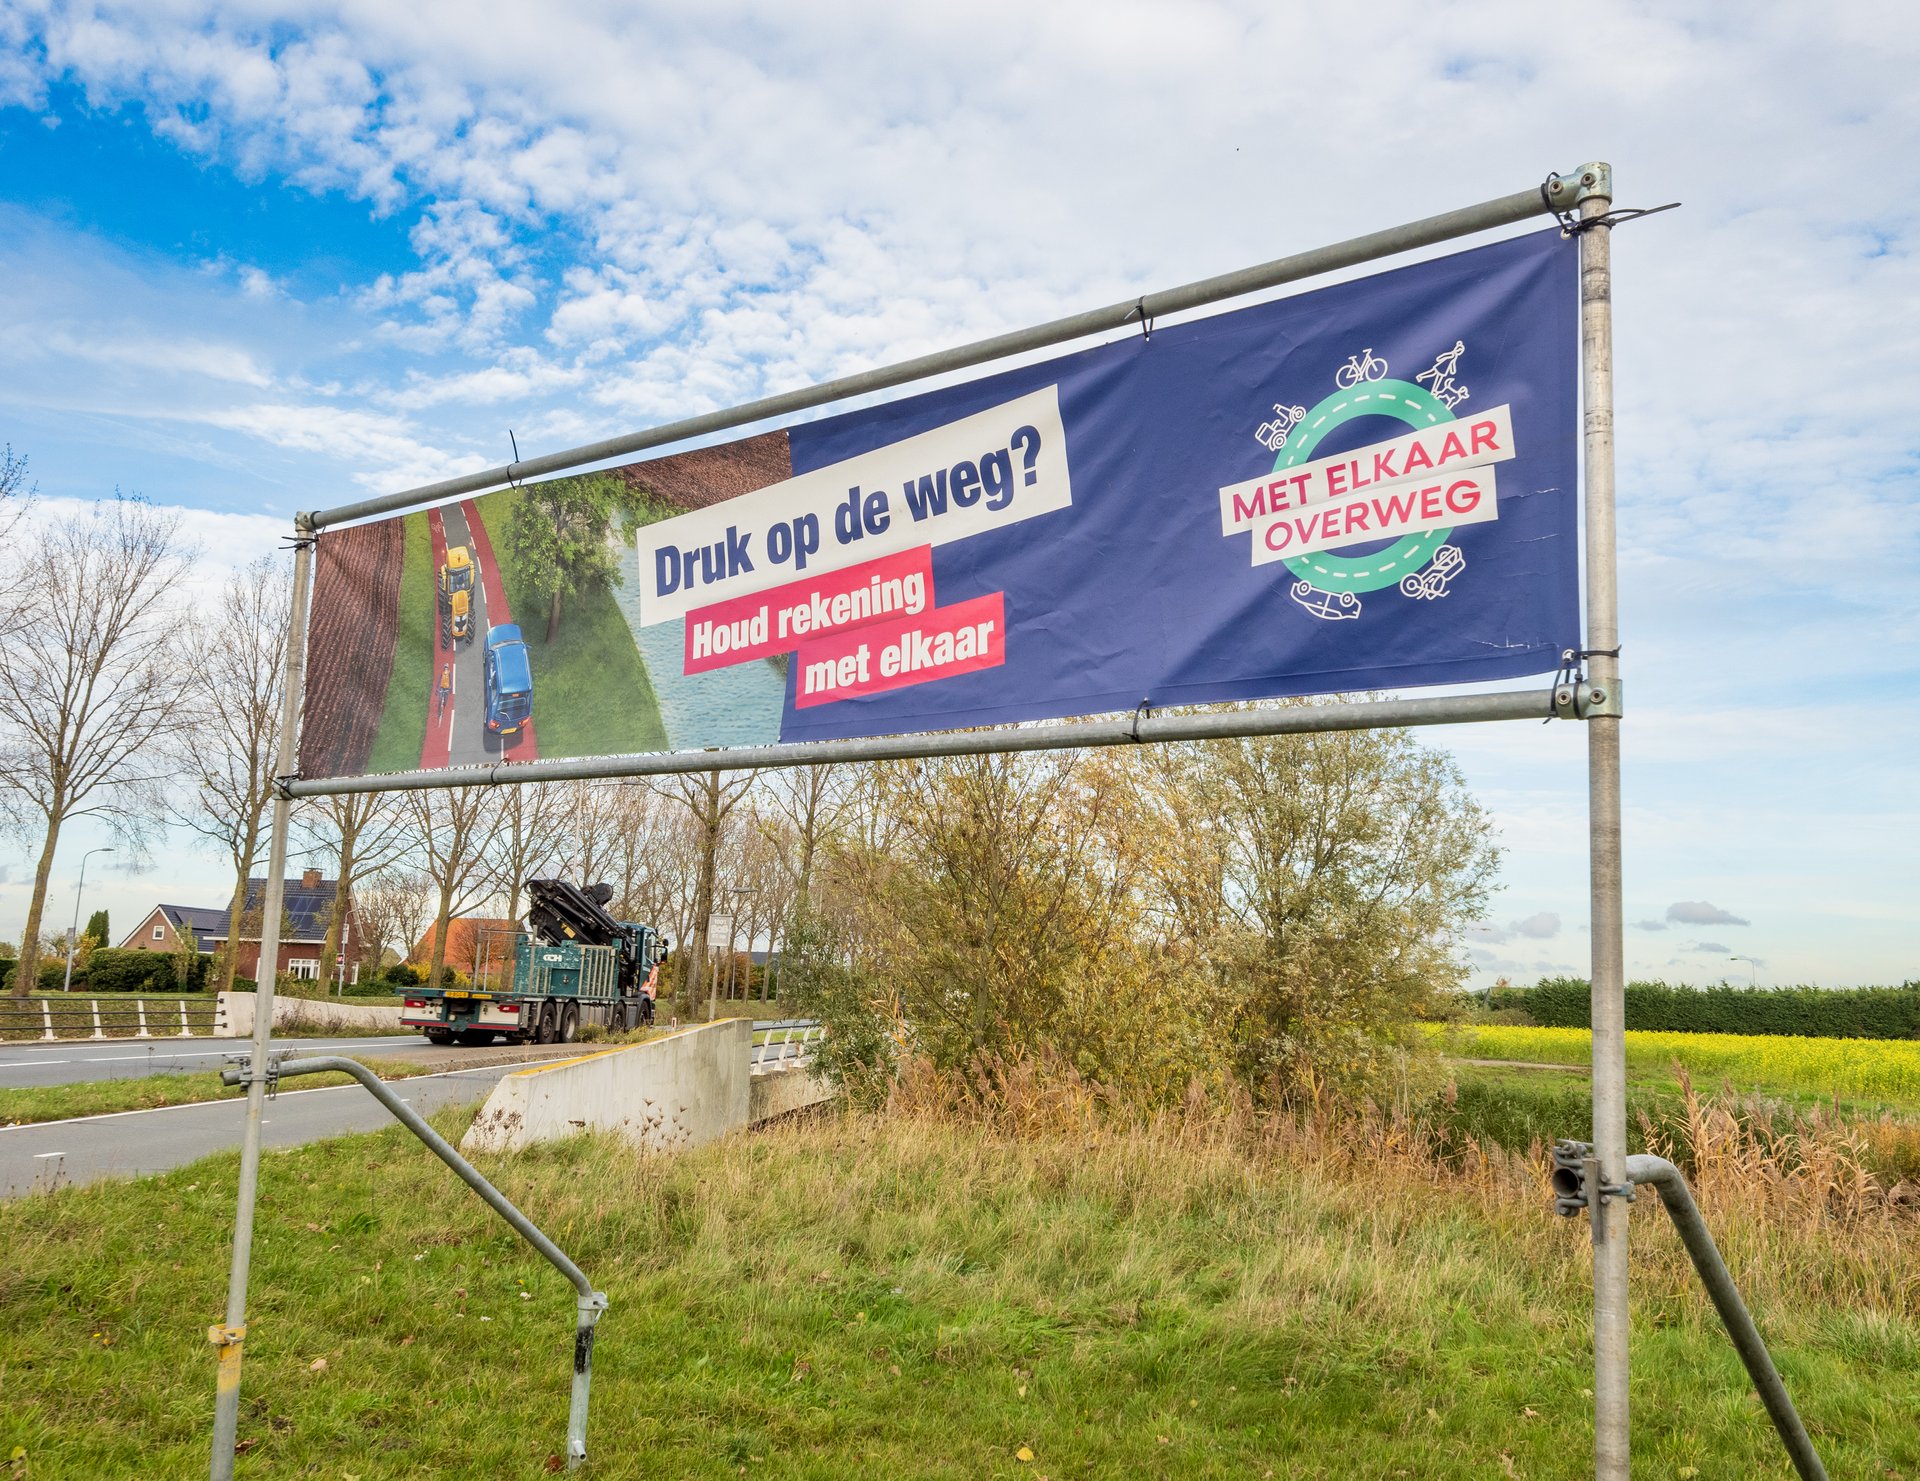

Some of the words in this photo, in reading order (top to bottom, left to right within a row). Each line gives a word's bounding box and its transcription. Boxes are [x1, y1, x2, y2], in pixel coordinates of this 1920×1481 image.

[655, 525, 755, 598] Druk
[767, 511, 820, 571] op
[835, 486, 891, 545] de
[903, 425, 1042, 522] weg?
[1233, 473, 1312, 522] MET
[1326, 420, 1501, 497] ELKAAR
[1264, 480, 1481, 551] OVERWEG
[692, 606, 769, 660] Houd
[778, 571, 926, 638] rekening
[804, 644, 871, 695] met
[880, 619, 995, 678] elkaar
